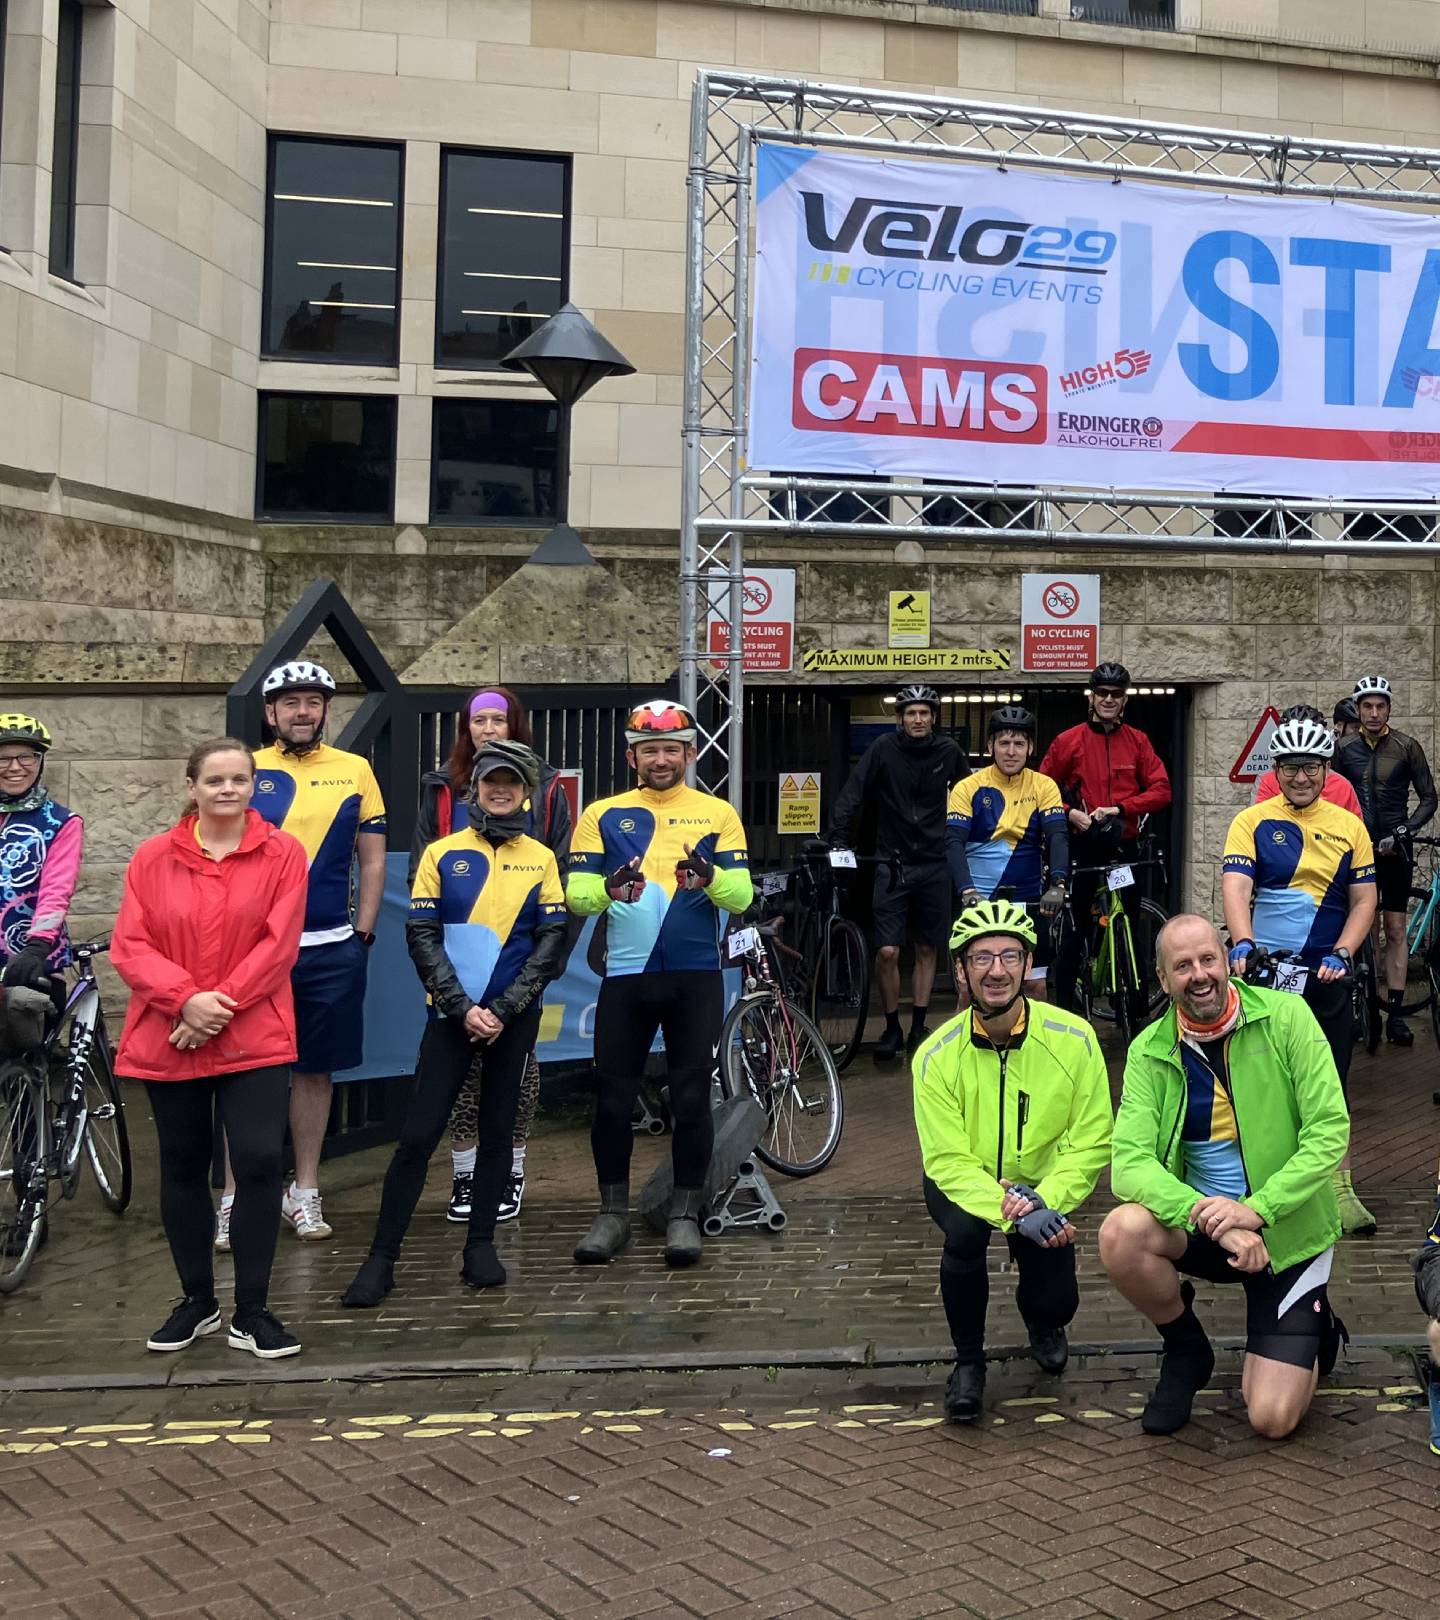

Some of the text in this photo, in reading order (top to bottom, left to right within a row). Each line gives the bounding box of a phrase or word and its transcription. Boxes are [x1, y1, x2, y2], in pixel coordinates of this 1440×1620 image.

[857, 265, 1104, 305] CYCLING EVENTS
[1059, 349, 1147, 393] HIGH5
[801, 358, 1039, 433] CAMS
[1058, 411, 1142, 436] ERDINGER
[1058, 433, 1162, 449] ALKOHOLFREI
[743, 626, 784, 636] YCLING
[1031, 629, 1090, 638] NO CYCLING
[816, 653, 997, 666] MAXIMUM HEIGHT 2 mtrs.
[788, 804, 810, 812] Ramp
[512, 864, 544, 872] AVIVA
[1114, 874, 1127, 885] 20
[735, 938, 746, 951] 21
